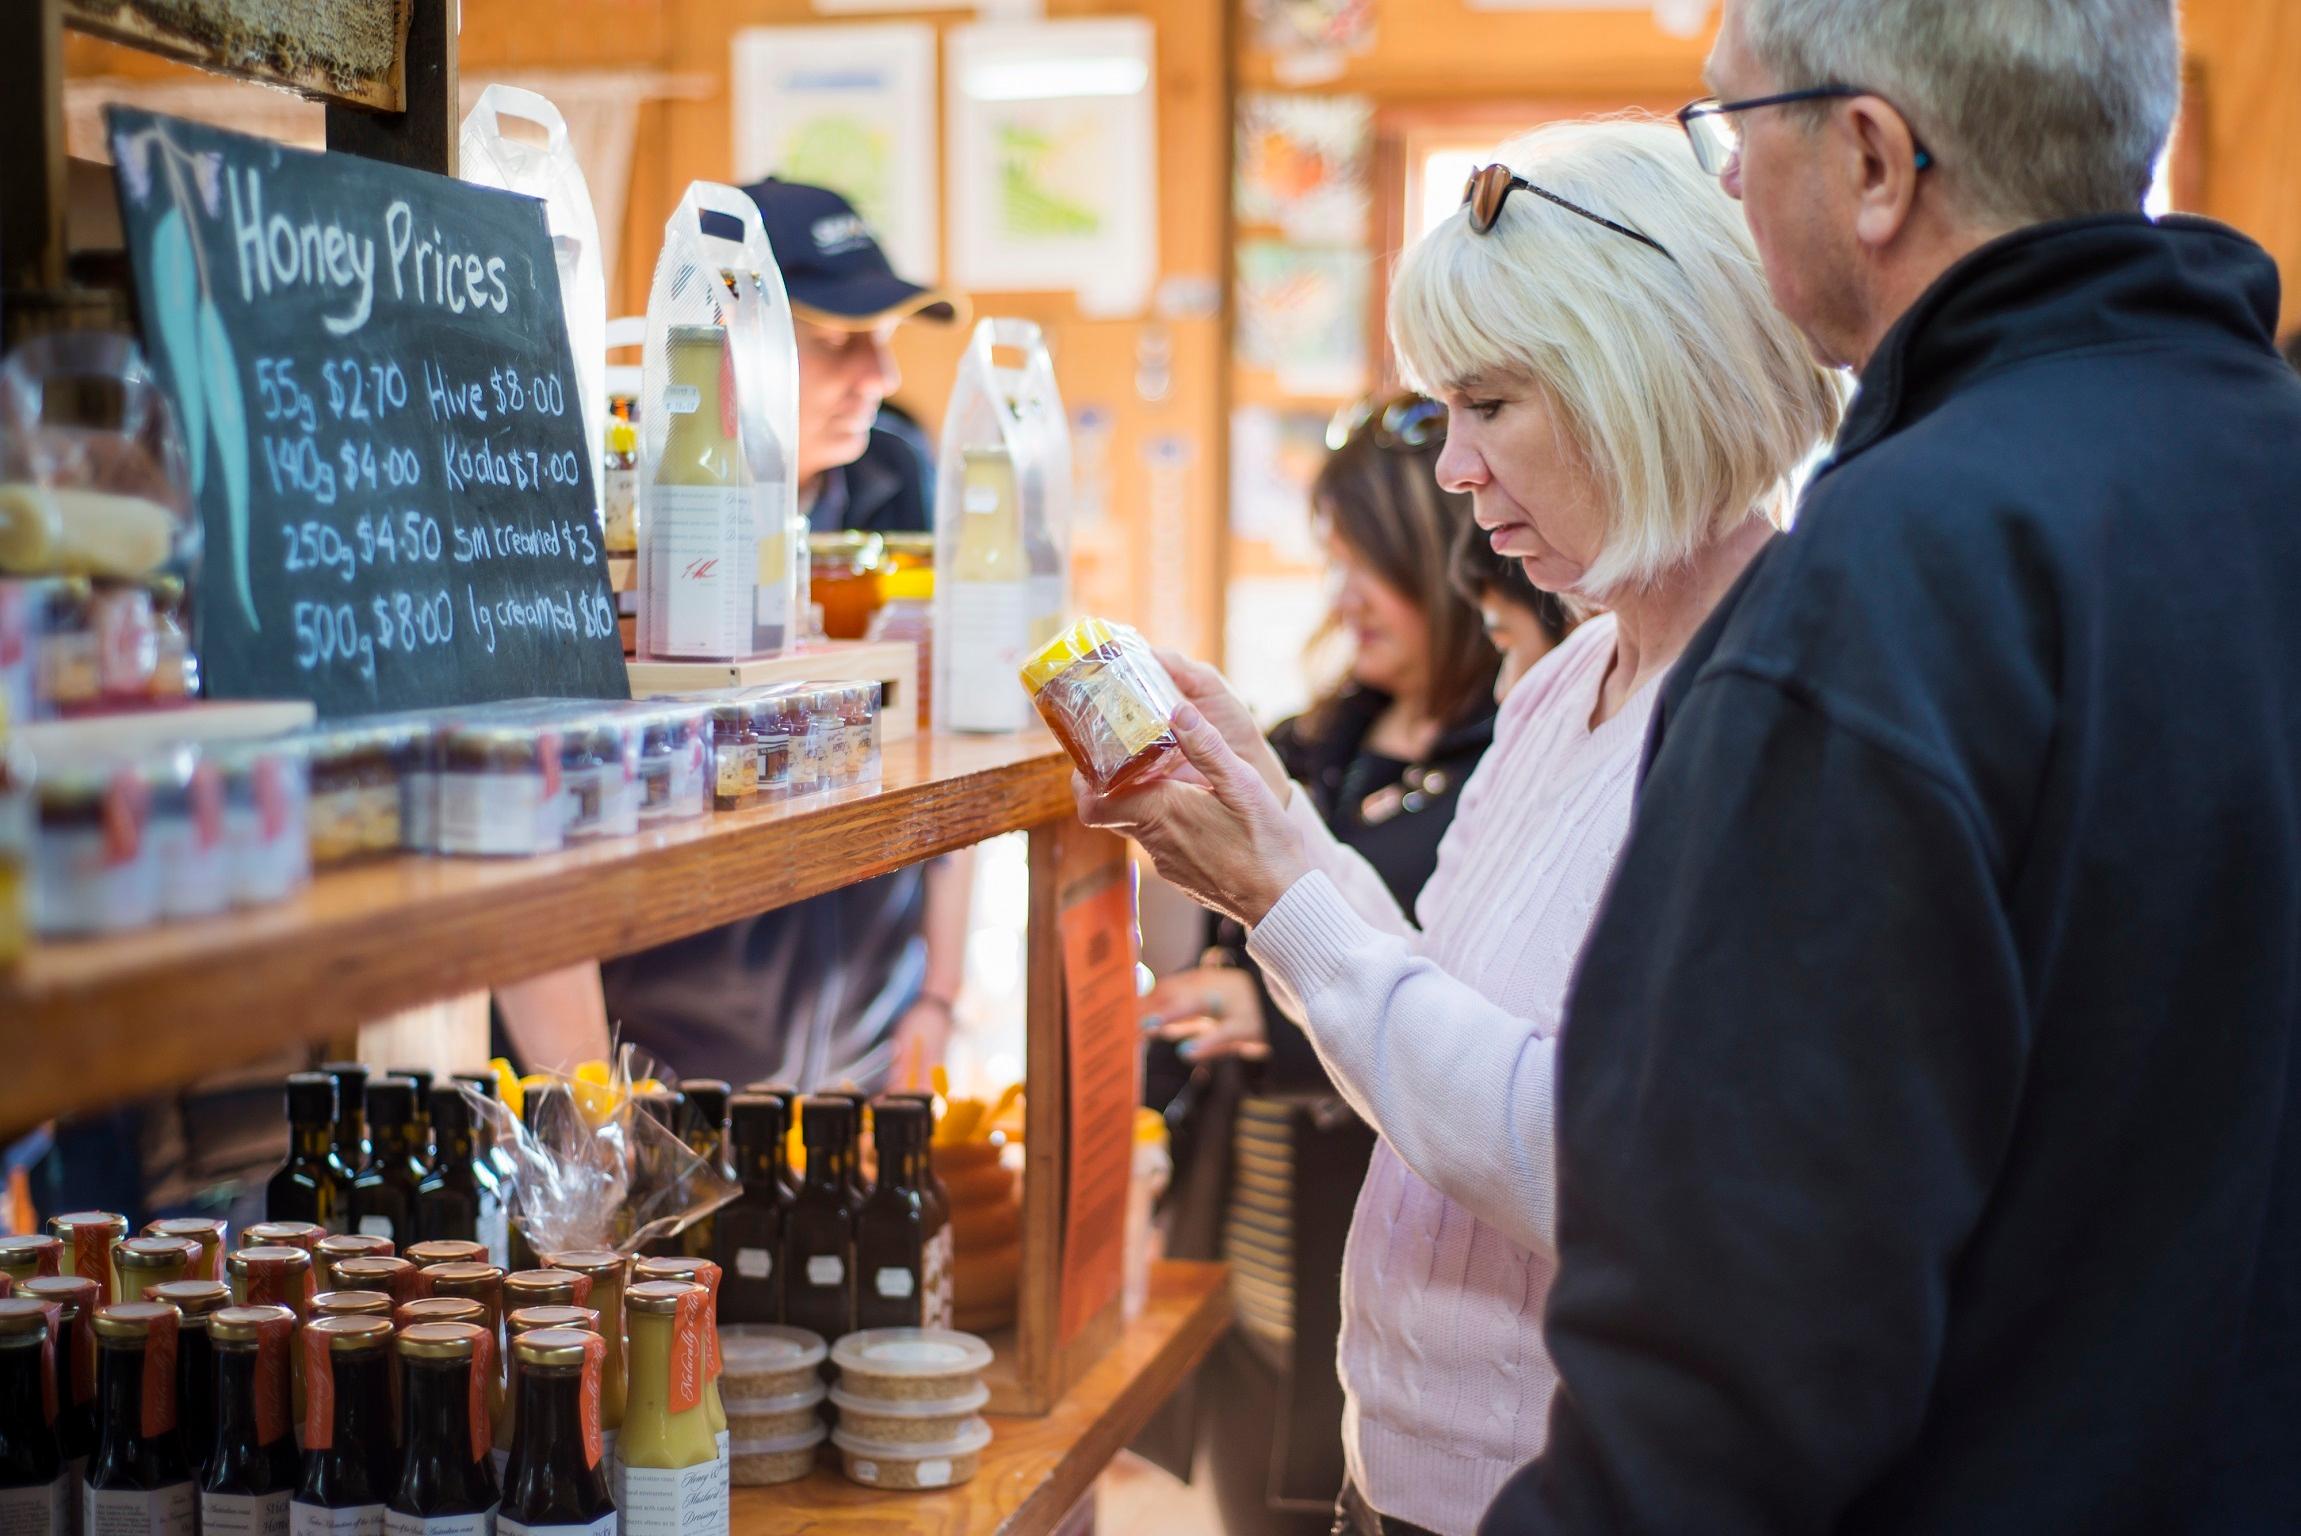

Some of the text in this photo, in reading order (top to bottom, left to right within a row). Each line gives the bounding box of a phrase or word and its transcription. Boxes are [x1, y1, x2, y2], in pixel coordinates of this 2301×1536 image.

[228, 165, 509, 336] Honey Prices
[255, 357, 407, 432] 55g $2.70
[424, 359, 564, 422] Hive $8.00
[263, 435, 420, 504] 140g $4.00
[444, 433, 579, 492] Koala $7.00
[282, 510, 441, 582] 250g $4.50
[561, 520, 597, 566] $3
[294, 590, 453, 682] 500g $8.00
[496, 590, 577, 640] creamed
[579, 585, 613, 640] $10
[680, 1330, 700, 1402] Naturally
